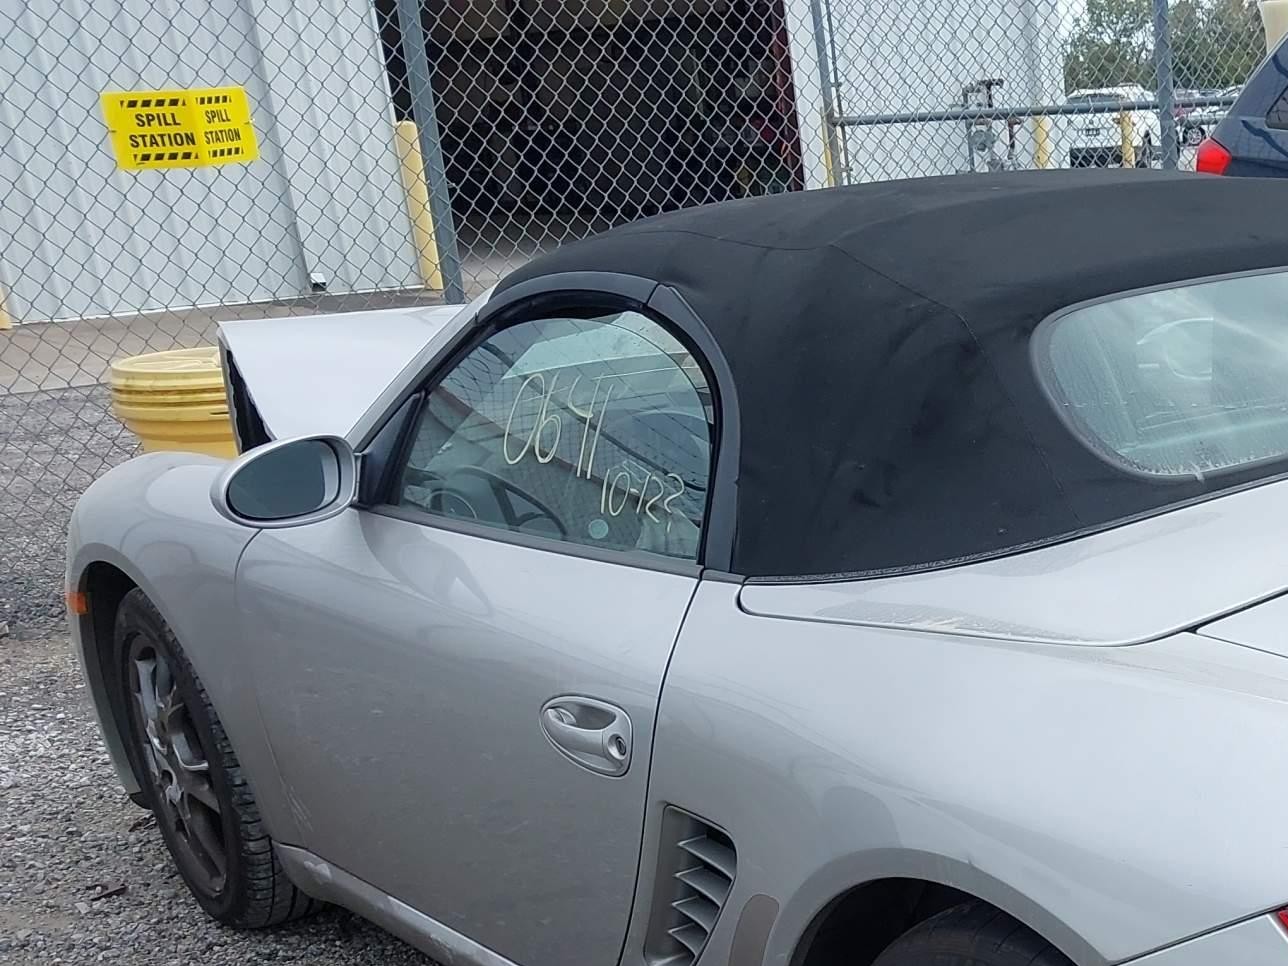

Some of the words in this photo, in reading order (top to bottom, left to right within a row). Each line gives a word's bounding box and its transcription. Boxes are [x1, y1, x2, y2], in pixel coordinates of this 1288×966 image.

[134, 112, 181, 128] SPILL
[205, 108, 231, 124] SPILL
[129, 131, 196, 149] STATION
[204, 127, 242, 146] STATION
